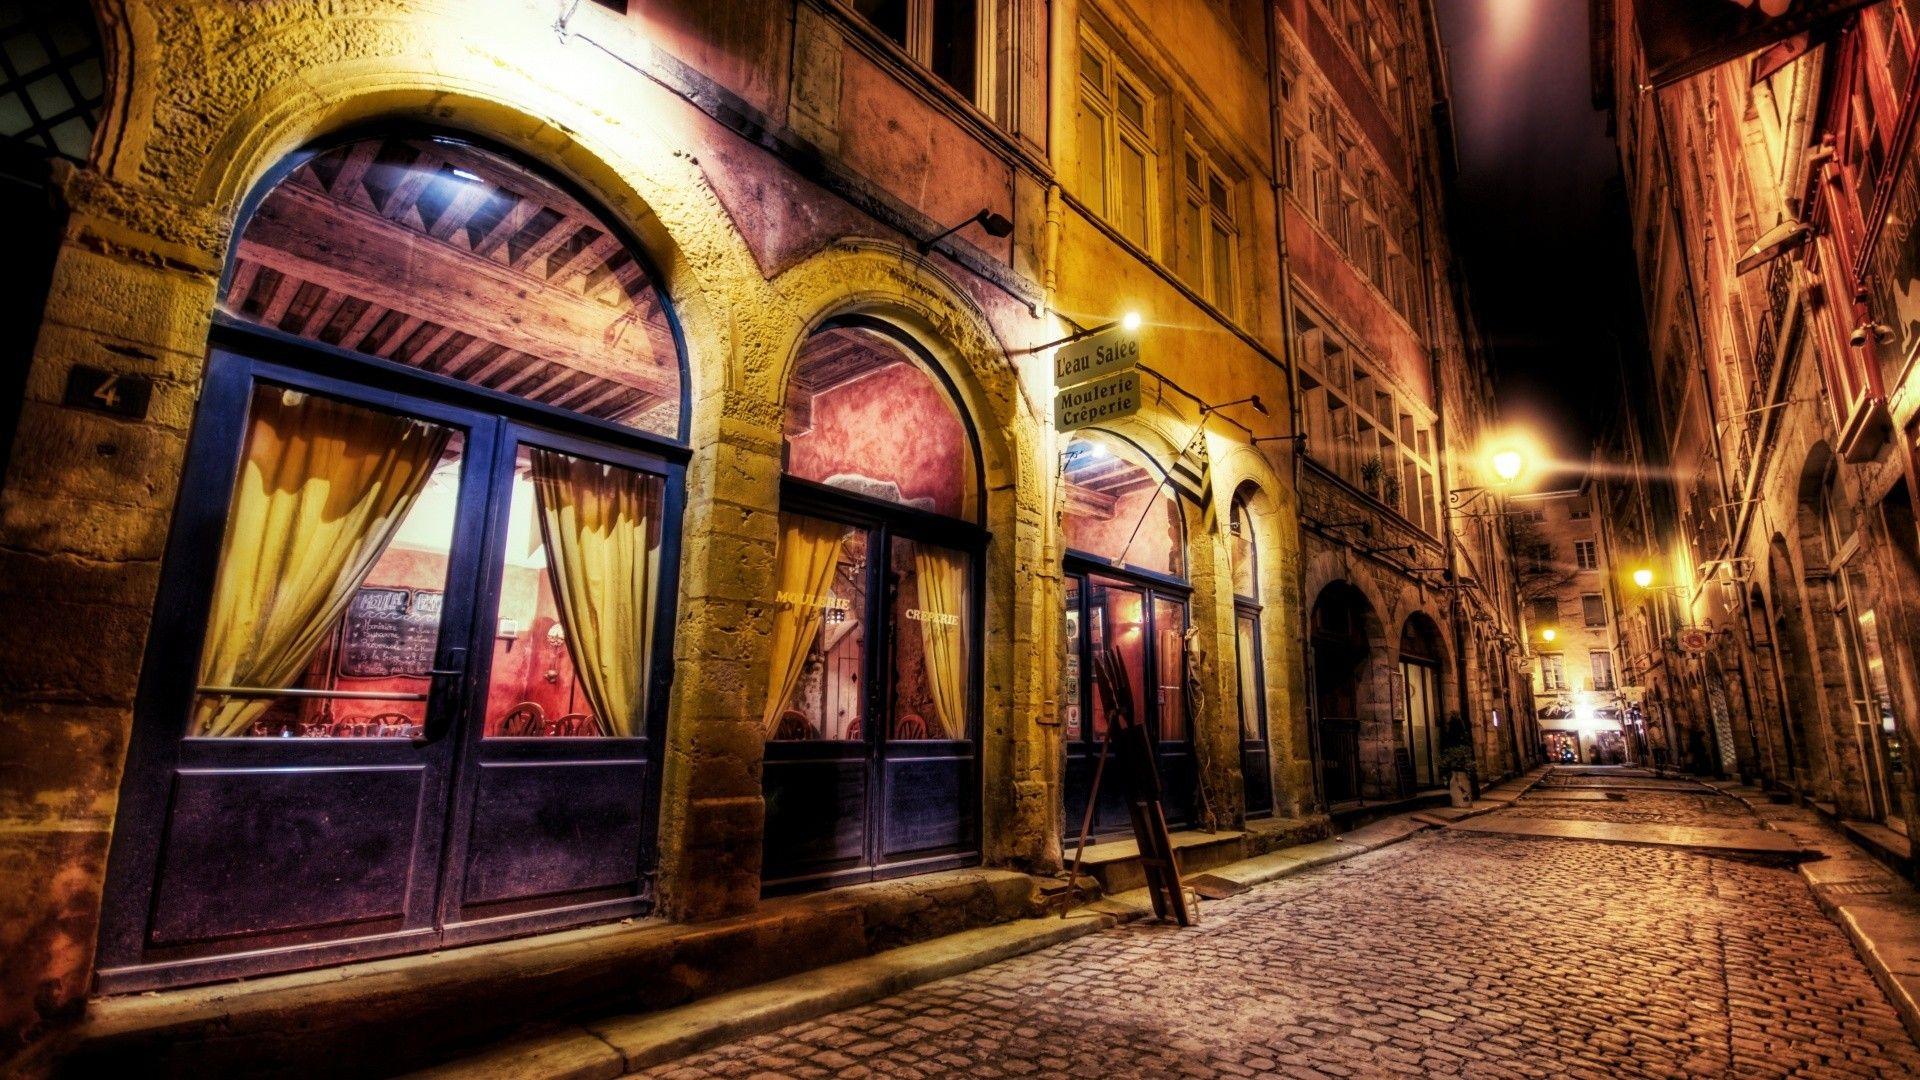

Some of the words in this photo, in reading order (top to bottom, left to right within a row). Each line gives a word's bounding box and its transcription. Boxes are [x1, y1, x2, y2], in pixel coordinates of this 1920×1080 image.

[1056, 355, 1090, 378] L'eau
[1096, 338, 1137, 365] Salée
[93, 374, 119, 407] 4
[1061, 379, 1133, 410] Moulerie
[1063, 397, 1132, 426] Crêperie
